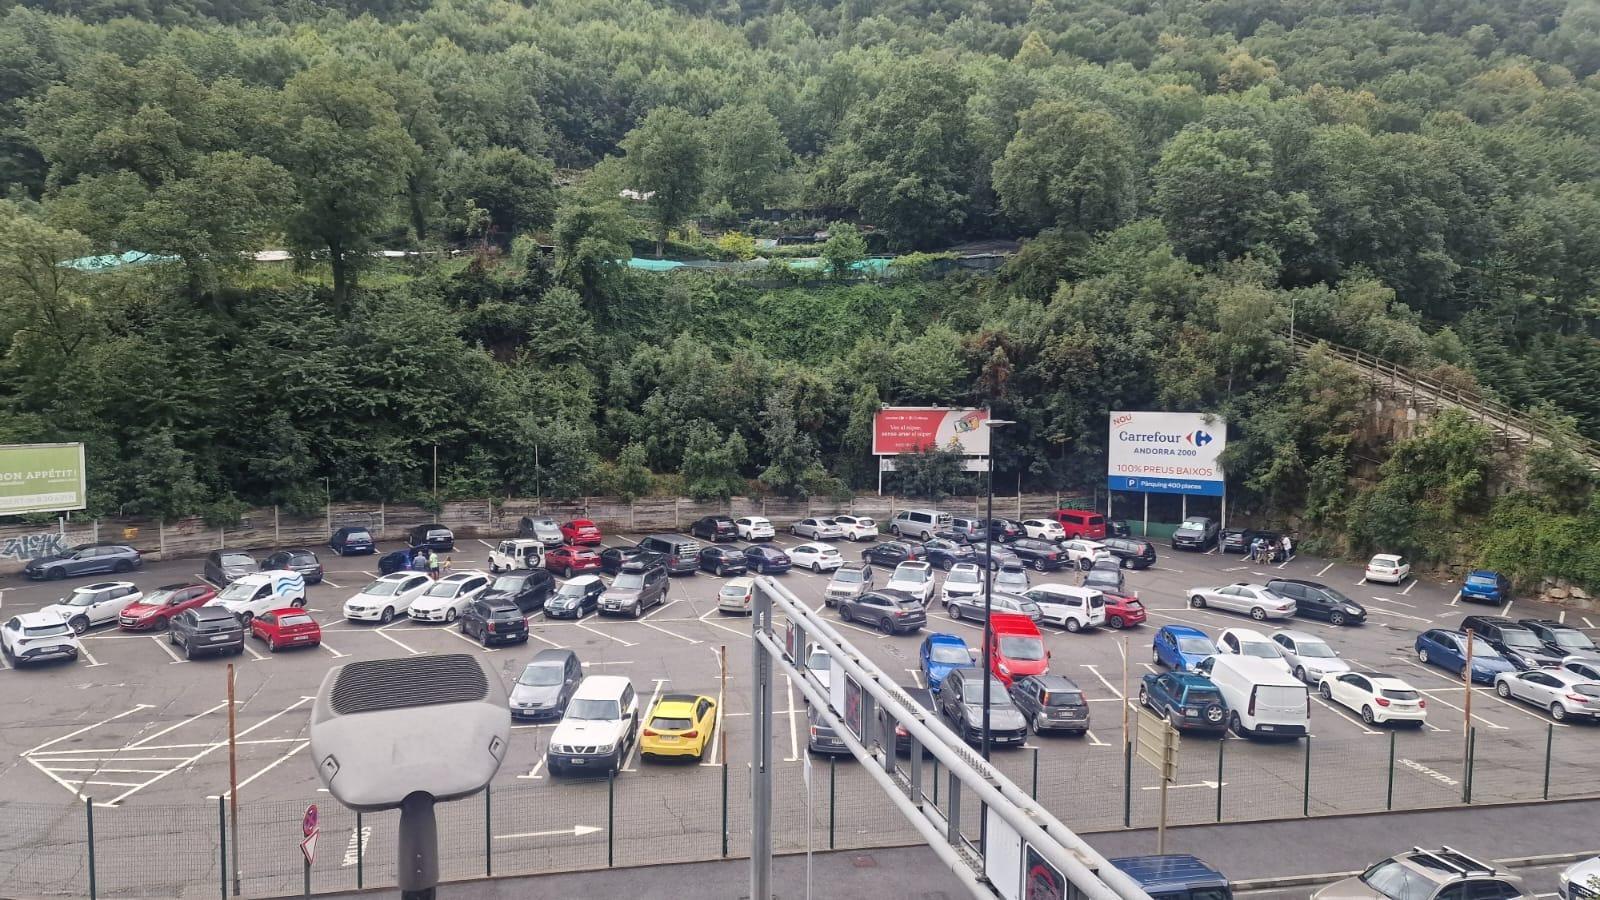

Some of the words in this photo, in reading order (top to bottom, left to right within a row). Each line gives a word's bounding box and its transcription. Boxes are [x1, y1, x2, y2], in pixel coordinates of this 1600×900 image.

[1113, 414, 1132, 425] NOU
[1119, 431, 1181, 443] Carrefour
[1134, 447, 1175, 456] ANDORRA
[1117, 464, 1142, 473] 100%
[1143, 465, 1174, 475] PREUS
[1176, 467, 1213, 477] BAIXOS
[1397, 759, 1459, 785] SORTIDA
